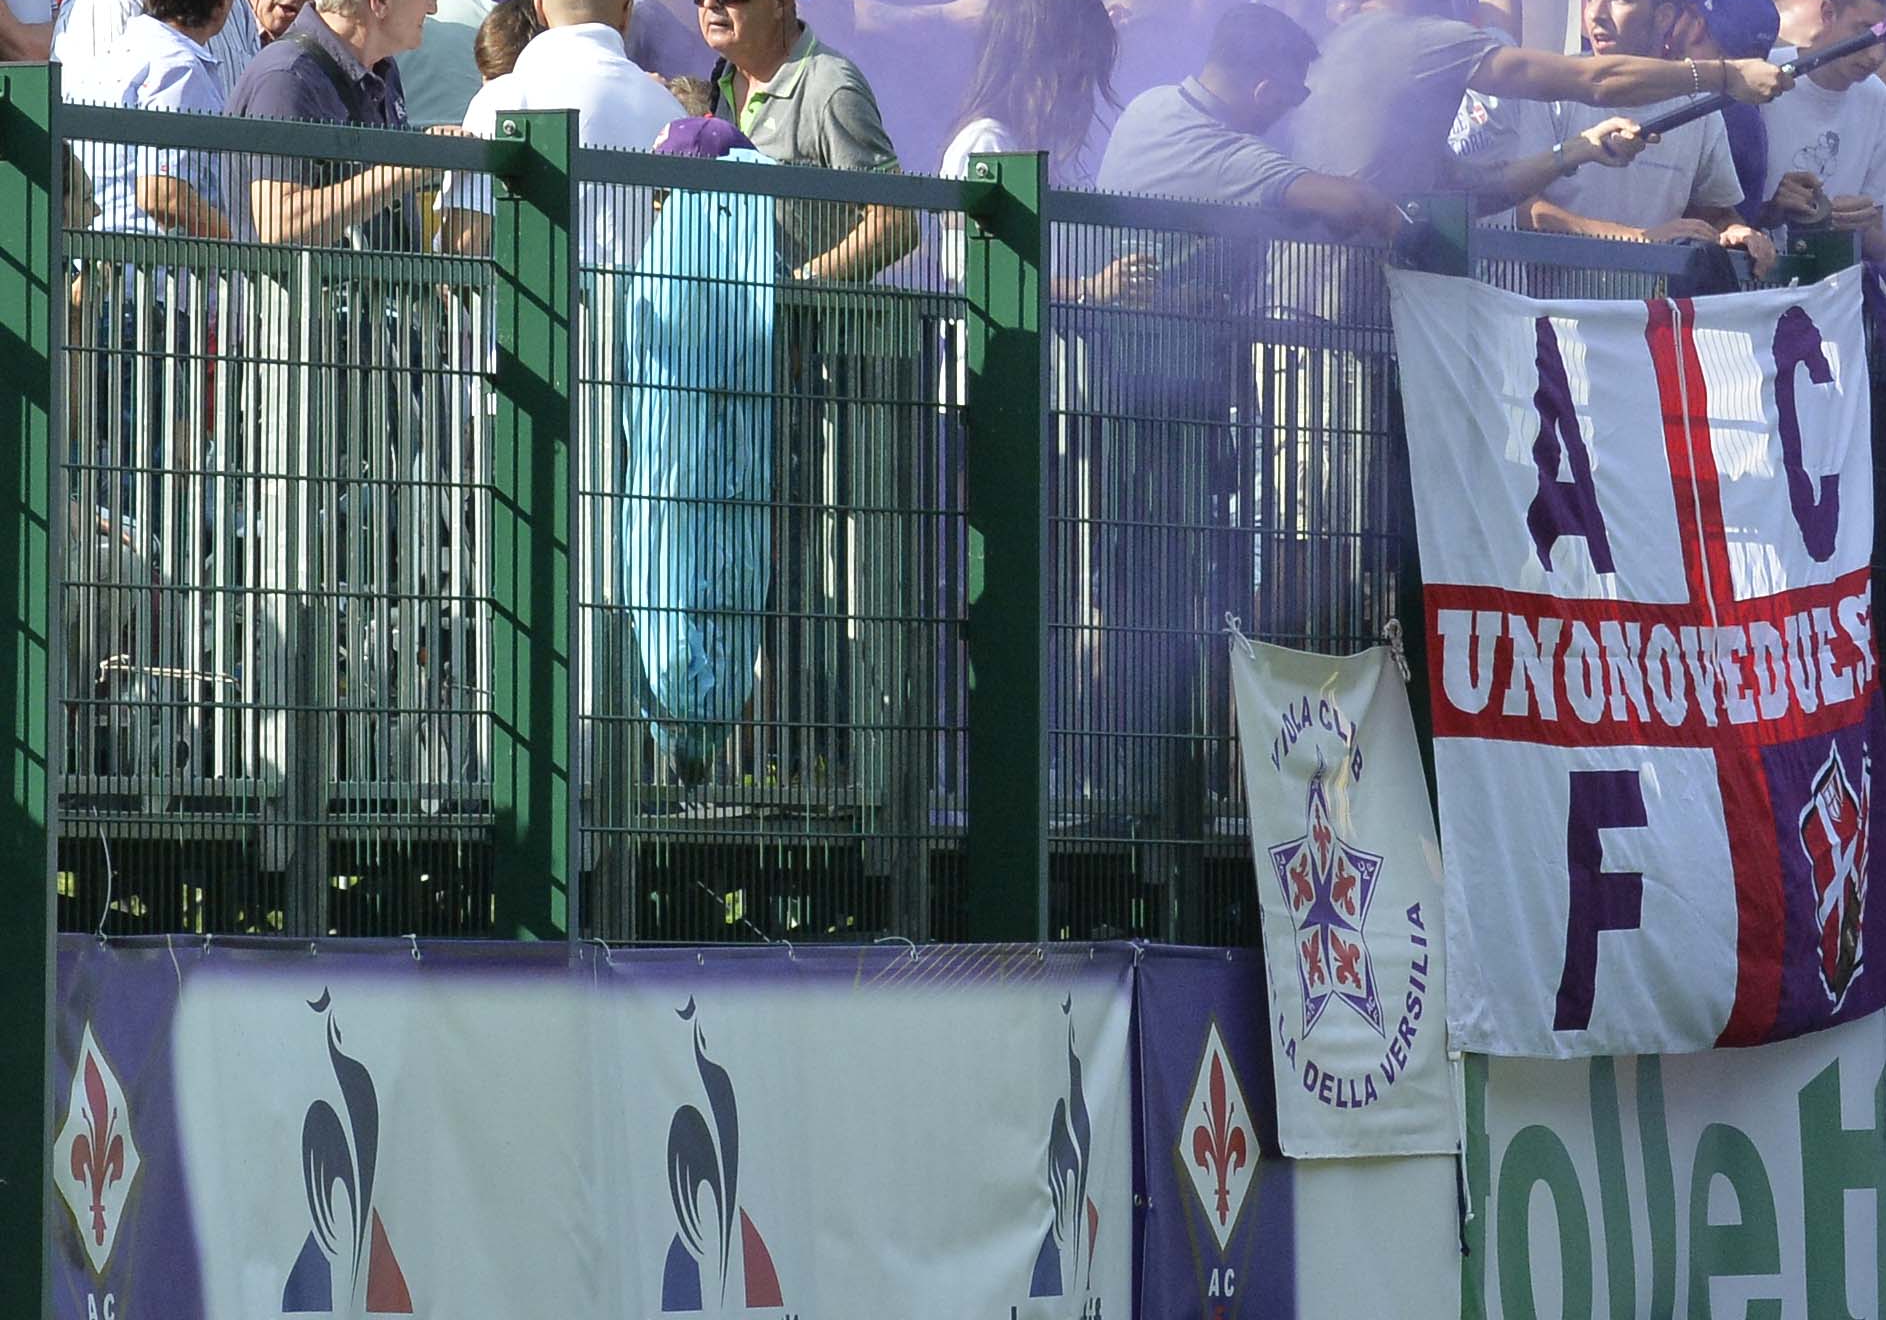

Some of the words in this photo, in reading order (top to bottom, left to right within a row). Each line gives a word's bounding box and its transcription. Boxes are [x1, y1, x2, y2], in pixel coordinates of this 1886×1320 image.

[1527, 316, 1615, 574] A
[1773, 305, 1841, 563] C
[1271, 694, 1313, 772] VIOLA
[1302, 1061, 1378, 1110] DELLA
[1380, 901, 1430, 1087] VERSILIA
[1553, 769, 1644, 1032] F
